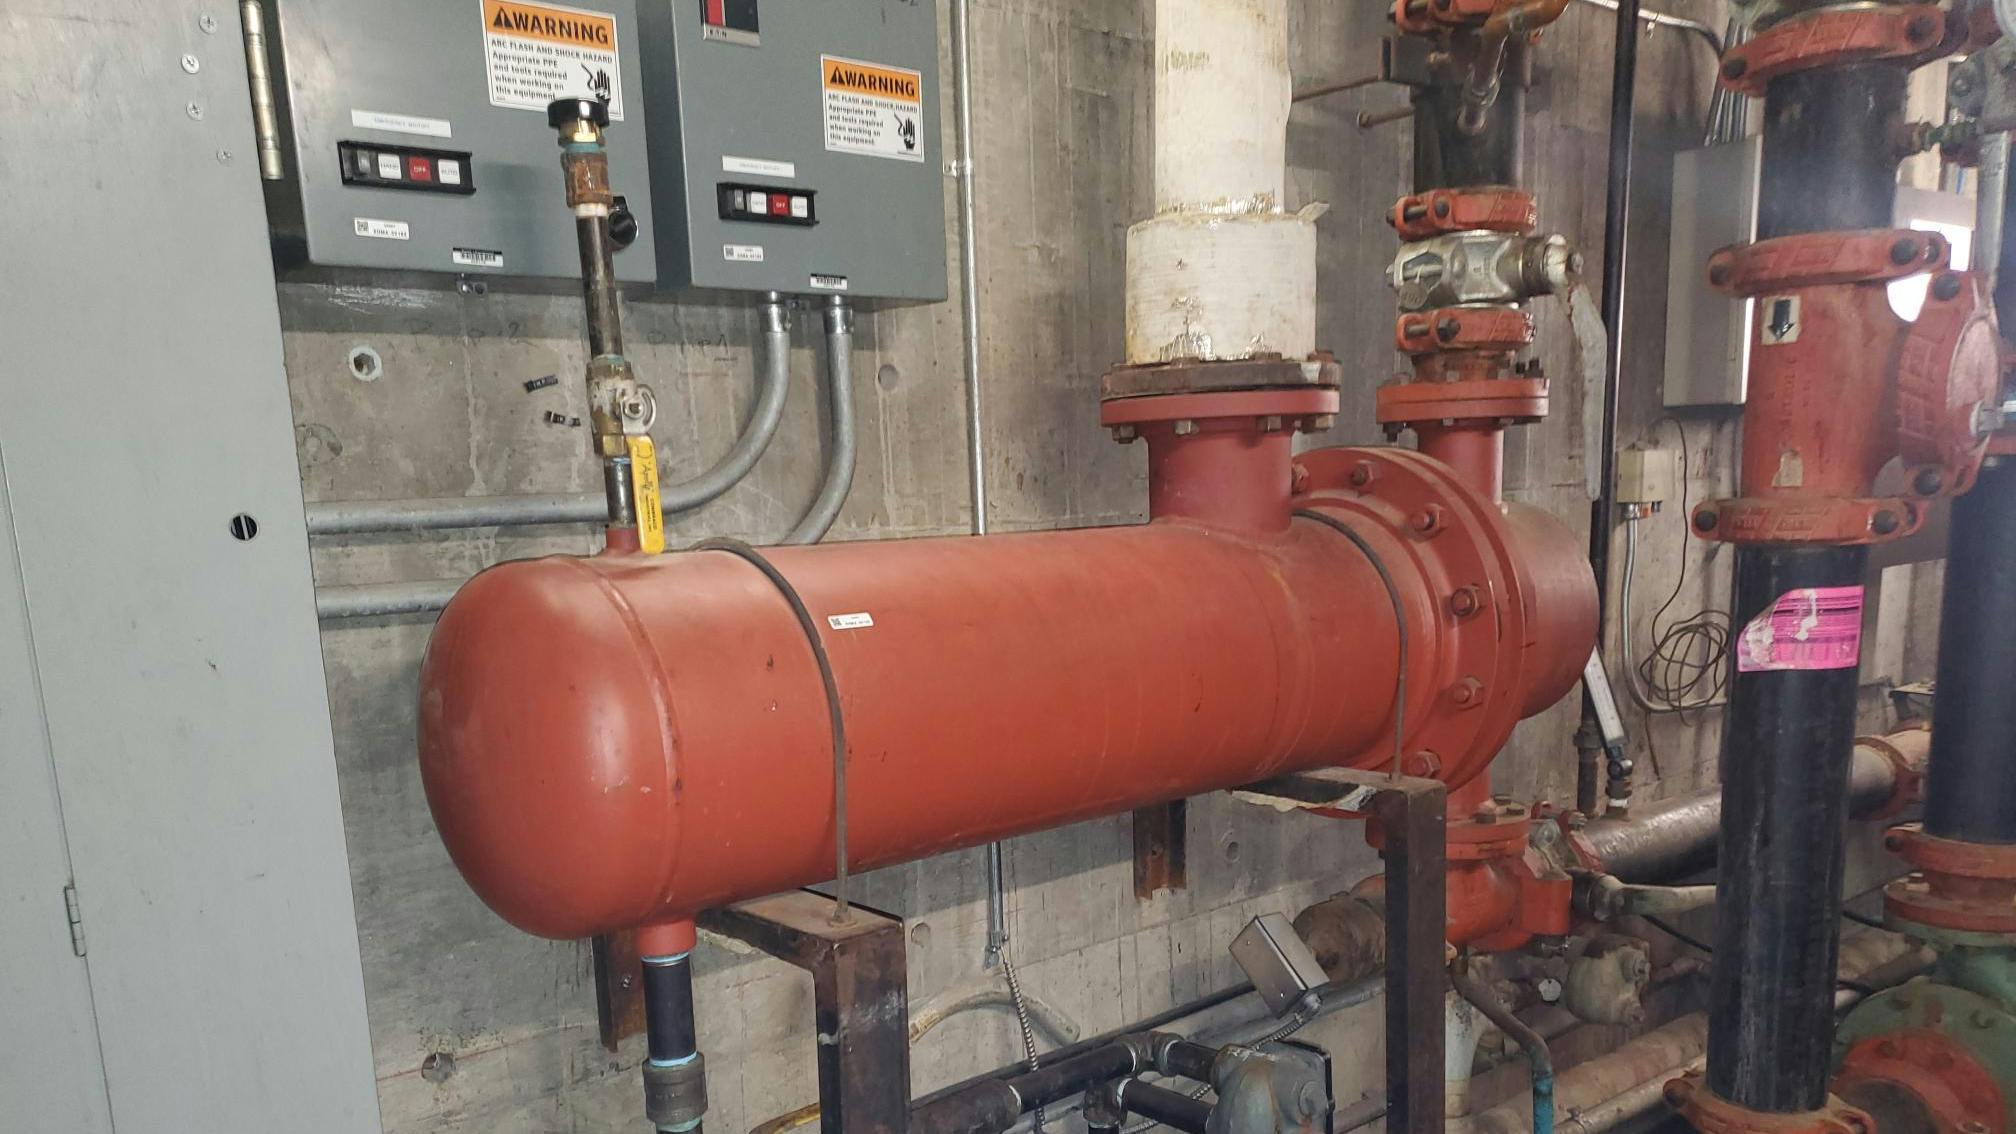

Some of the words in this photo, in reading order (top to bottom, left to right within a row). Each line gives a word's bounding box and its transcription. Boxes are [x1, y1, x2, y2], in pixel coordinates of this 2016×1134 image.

[512, 12, 608, 45] WARNING
[491, 39, 507, 49] ARC
[510, 42, 534, 53] FLASH
[536, 46, 553, 55] AND
[555, 48, 580, 59] SHOCK
[583, 52, 613, 64] HAZARD
[493, 52, 541, 66] Appropriate
[543, 58, 558, 68] PPE
[494, 63, 509, 73] and
[512, 64, 532, 76] tools
[534, 69, 568, 81] required
[495, 74, 517, 85] when
[519, 77, 552, 91] working
[554, 83, 564, 91] on
[496, 86, 512, 95] this
[845, 70, 915, 97] WARNING
[828, 104, 864, 116] Appropriate
[865, 109, 877, 117] PPE
[829, 114, 841, 122] and
[842, 115, 858, 124] tools
[859, 118, 884, 129] required
[829, 125, 846, 133] when
[848, 126, 872, 137] working
